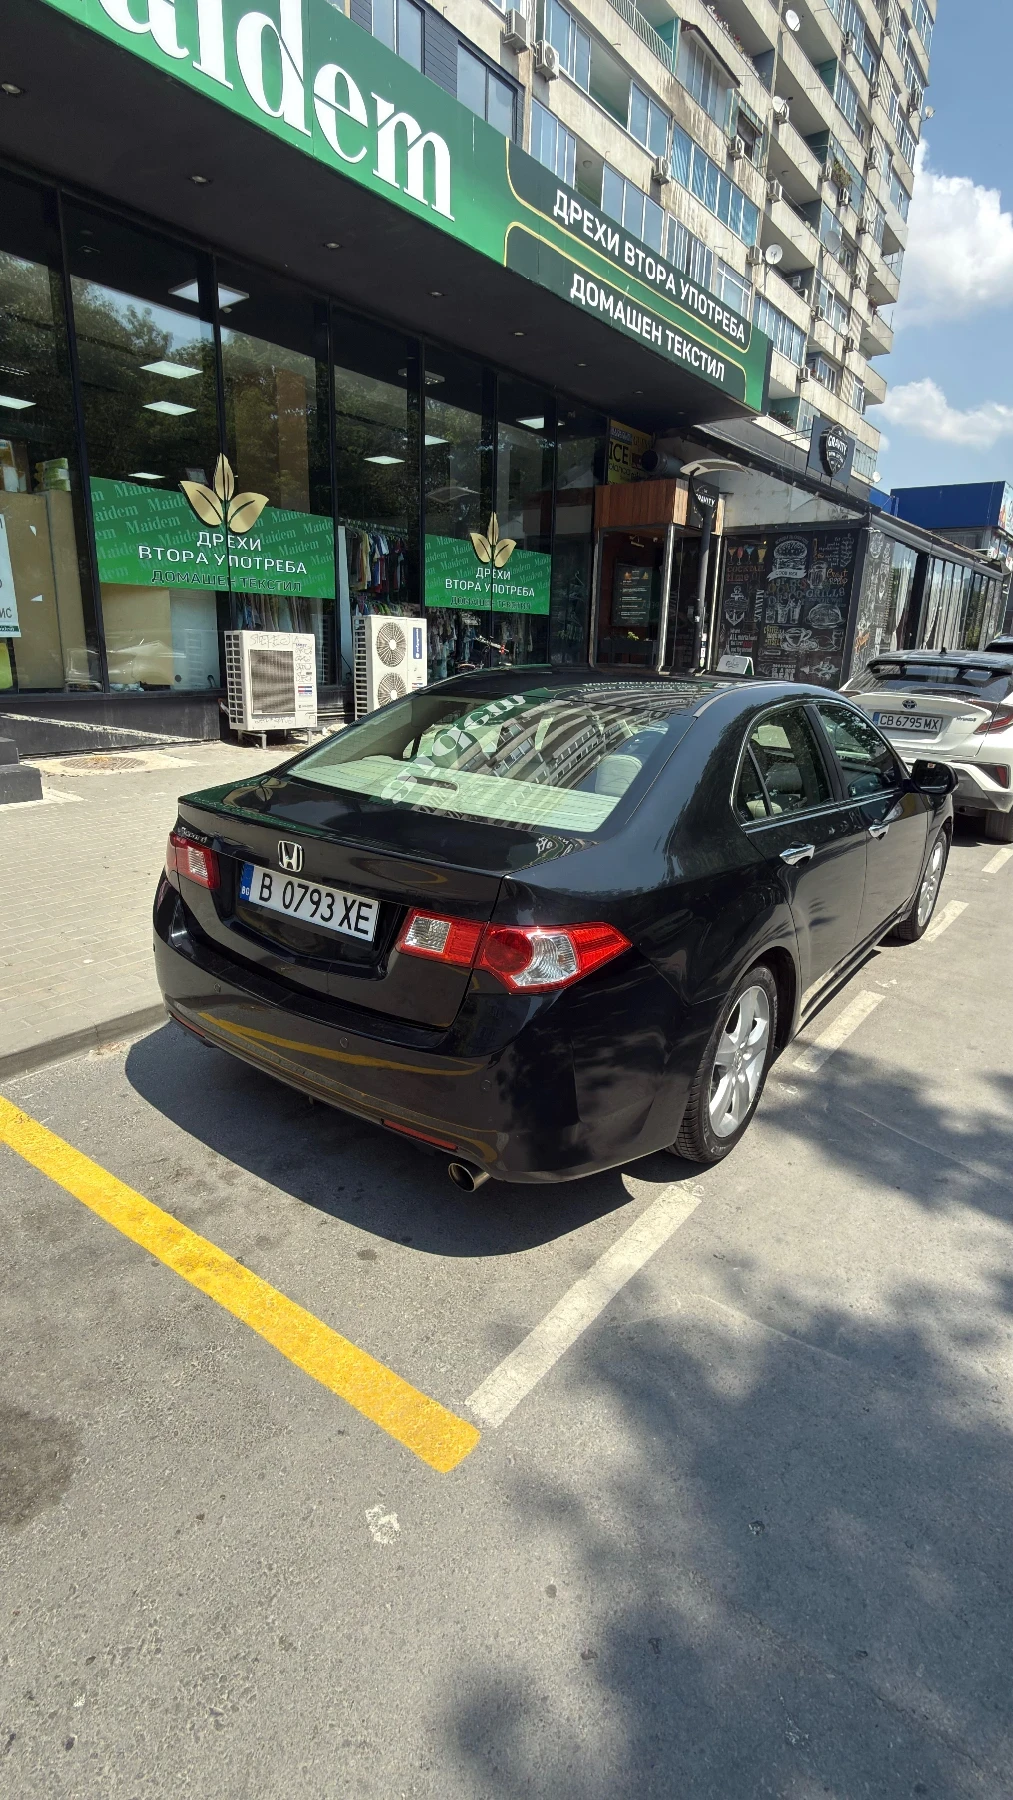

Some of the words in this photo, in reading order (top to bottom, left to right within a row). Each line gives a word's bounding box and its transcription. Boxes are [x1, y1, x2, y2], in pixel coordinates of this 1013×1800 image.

[553, 188, 620, 257] ДРЕХИ
[624, 240, 676, 295] ВТОРА
[680, 278, 745, 344] УПОТРЕБА
[570, 272, 662, 346] ДОМАШЕН
[666, 329, 725, 382] ТЕКСТИЛ
[125, 515, 181, 535] Maidem
[197, 531, 262, 552] ДРЕХИ
[279, 540, 319, 557] Maidem
[138, 545, 209, 565] ВТОРА
[213, 553, 308, 575] УПОТРЕБА
[240, 576, 302, 592] ТЕКСТИЛ
[475, 567, 511, 581] ДРЕХИ
[445, 578, 482, 592] ВТОРА
[484, 583, 535, 597] УПОТРЕБА
[753, 589, 765, 622] ALWAYS
[880, 715, 894, 726] CB
[895, 715, 922, 728] 6795
[923, 718, 939, 730] MX
[241, 886, 250, 896] BG
[259, 872, 273, 902] B
[282, 880, 336, 923] 0793
[338, 896, 373, 935] XE
